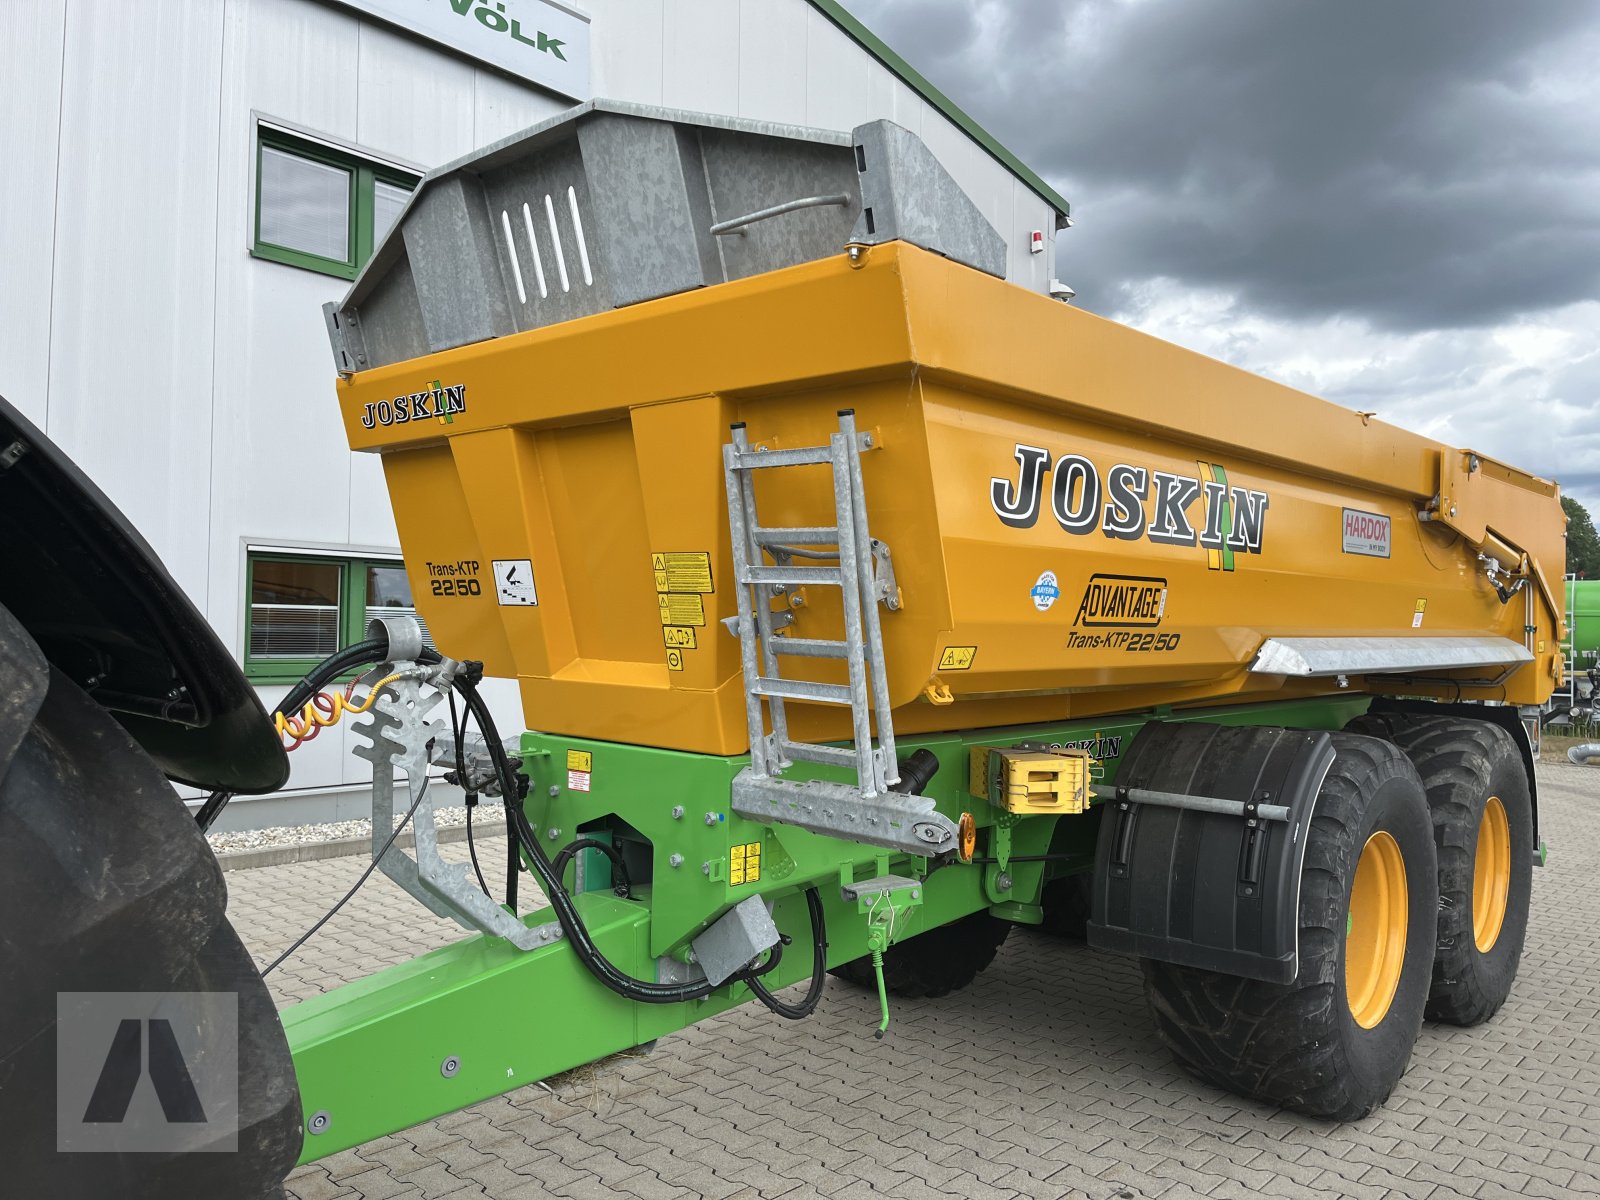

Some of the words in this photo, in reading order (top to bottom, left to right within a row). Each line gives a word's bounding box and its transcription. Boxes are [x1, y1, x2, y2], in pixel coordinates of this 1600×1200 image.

[361, 384, 466, 429] JOSKIN
[990, 443, 1269, 554] JOSKIN
[1345, 513, 1388, 542] HARDOX
[426, 560, 479, 576] Trans-KTP
[431, 578, 481, 597] 22/50
[1072, 584, 1161, 627] ADVANTAGE
[1066, 631, 1130, 649] Trans-KTP
[1125, 632, 1181, 652] 22/50
